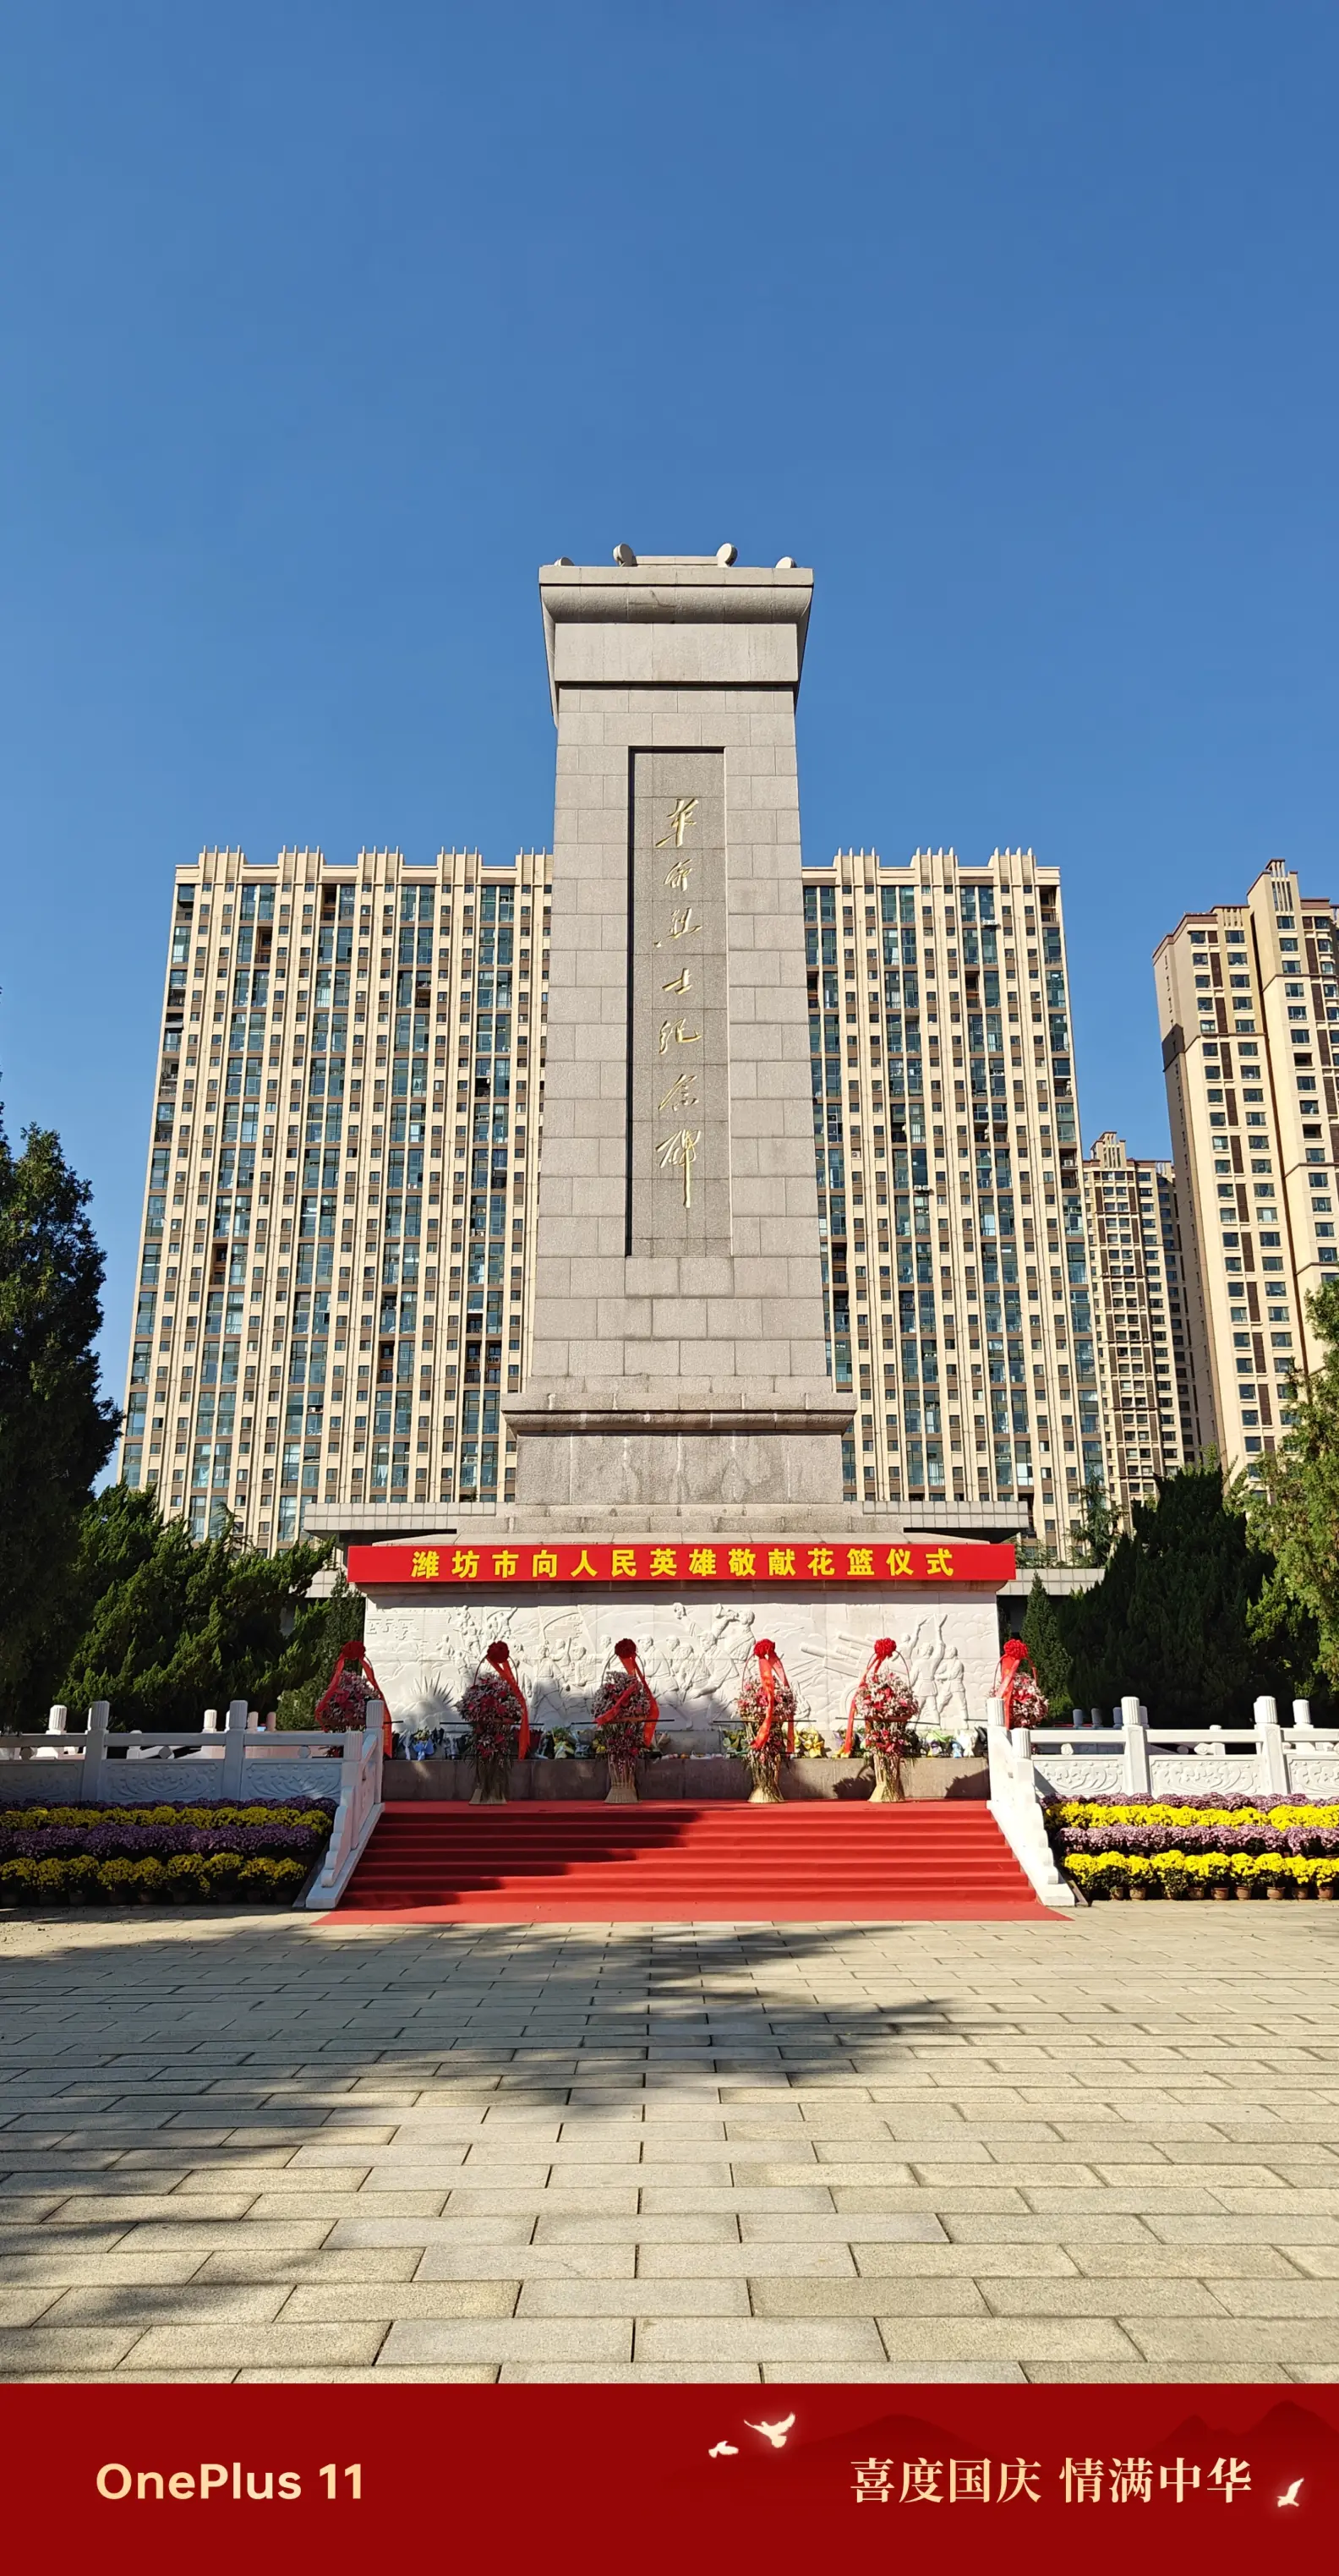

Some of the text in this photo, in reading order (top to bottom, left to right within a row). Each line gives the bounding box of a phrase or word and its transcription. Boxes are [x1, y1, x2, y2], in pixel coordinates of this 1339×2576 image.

[411, 1548, 955, 1579] 潍坊市向人民英雄敬献花篮仪式
